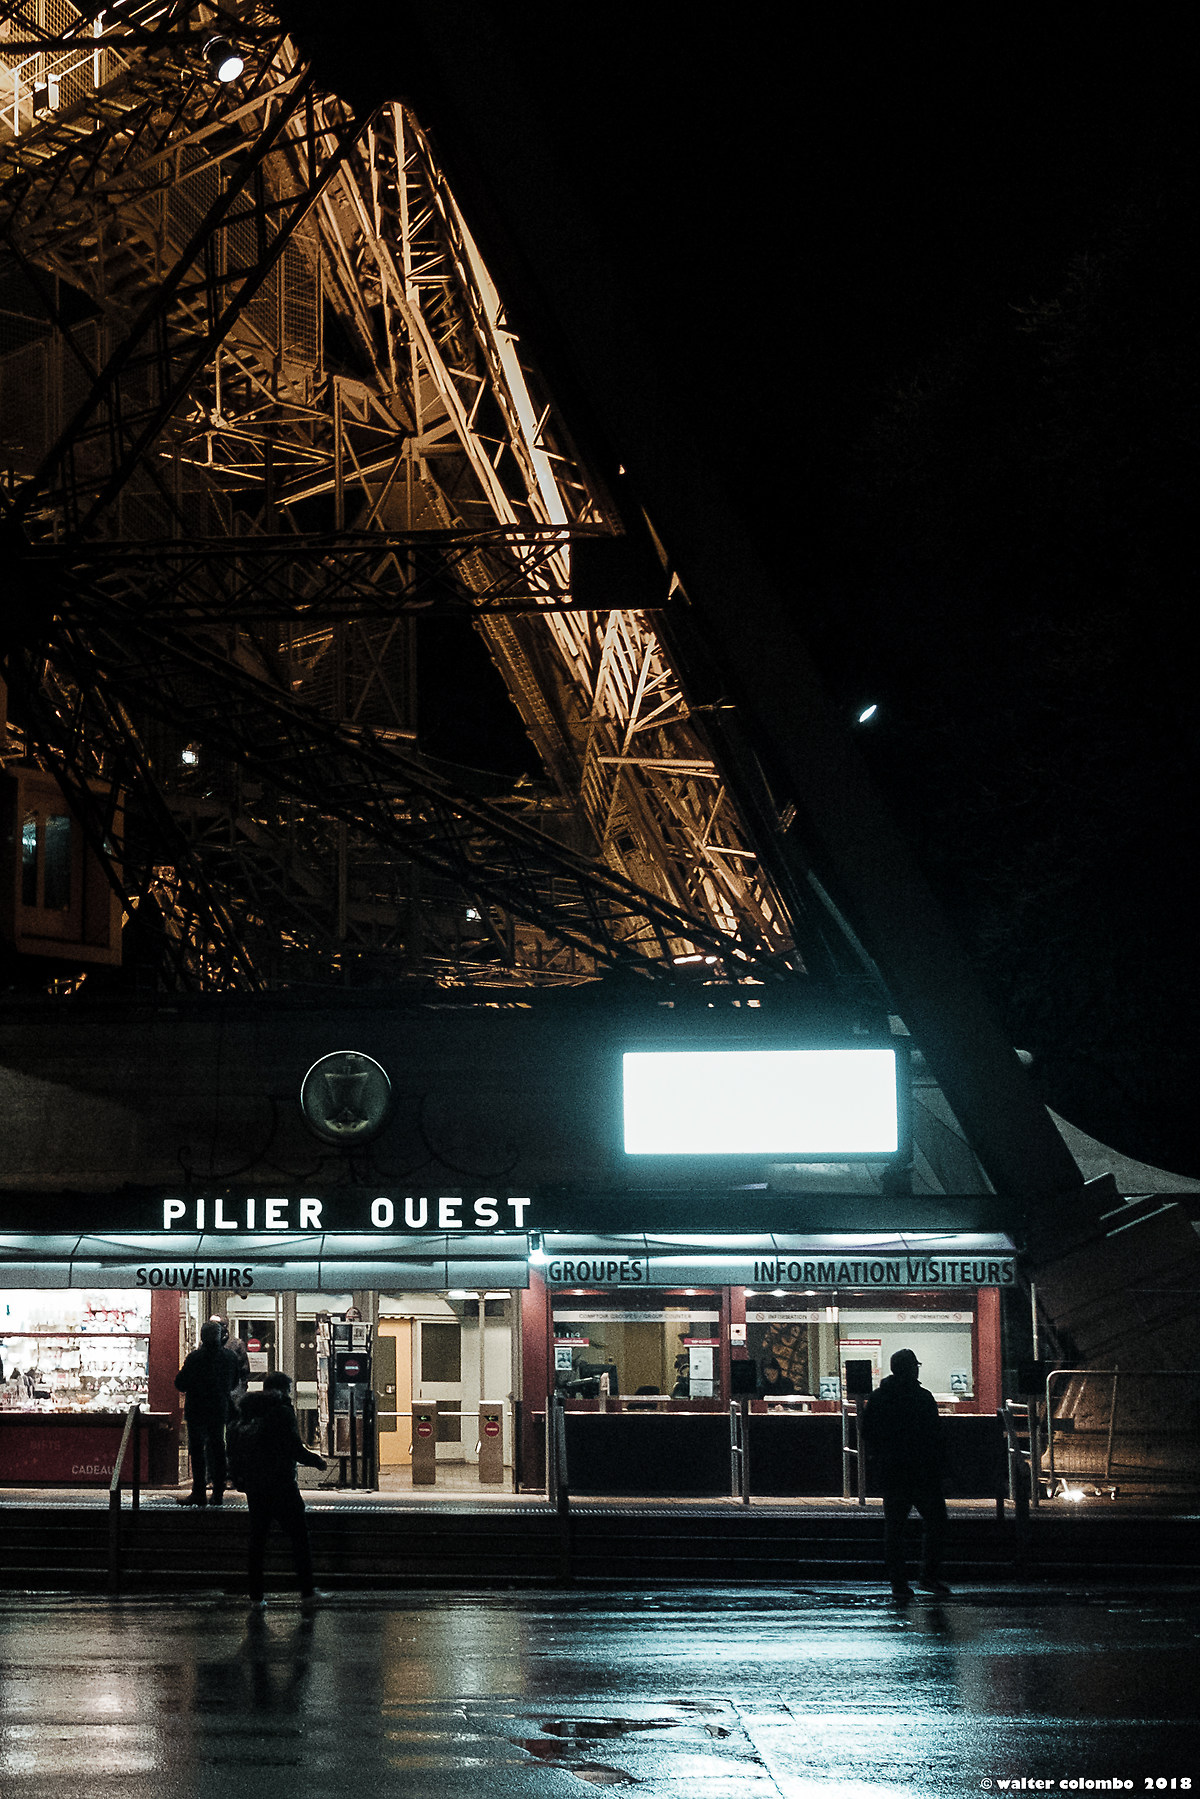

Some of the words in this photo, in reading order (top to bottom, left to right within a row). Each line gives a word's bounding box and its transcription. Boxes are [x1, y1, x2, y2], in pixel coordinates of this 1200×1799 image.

[163, 1198, 323, 1229] PILIER
[371, 1197, 531, 1228] OUEST
[136, 1267, 254, 1288] SOUVENIRS
[548, 1261, 643, 1282] GROUPES
[754, 1261, 899, 1283] INFORMATION
[906, 1261, 1015, 1284] VISITEURS
